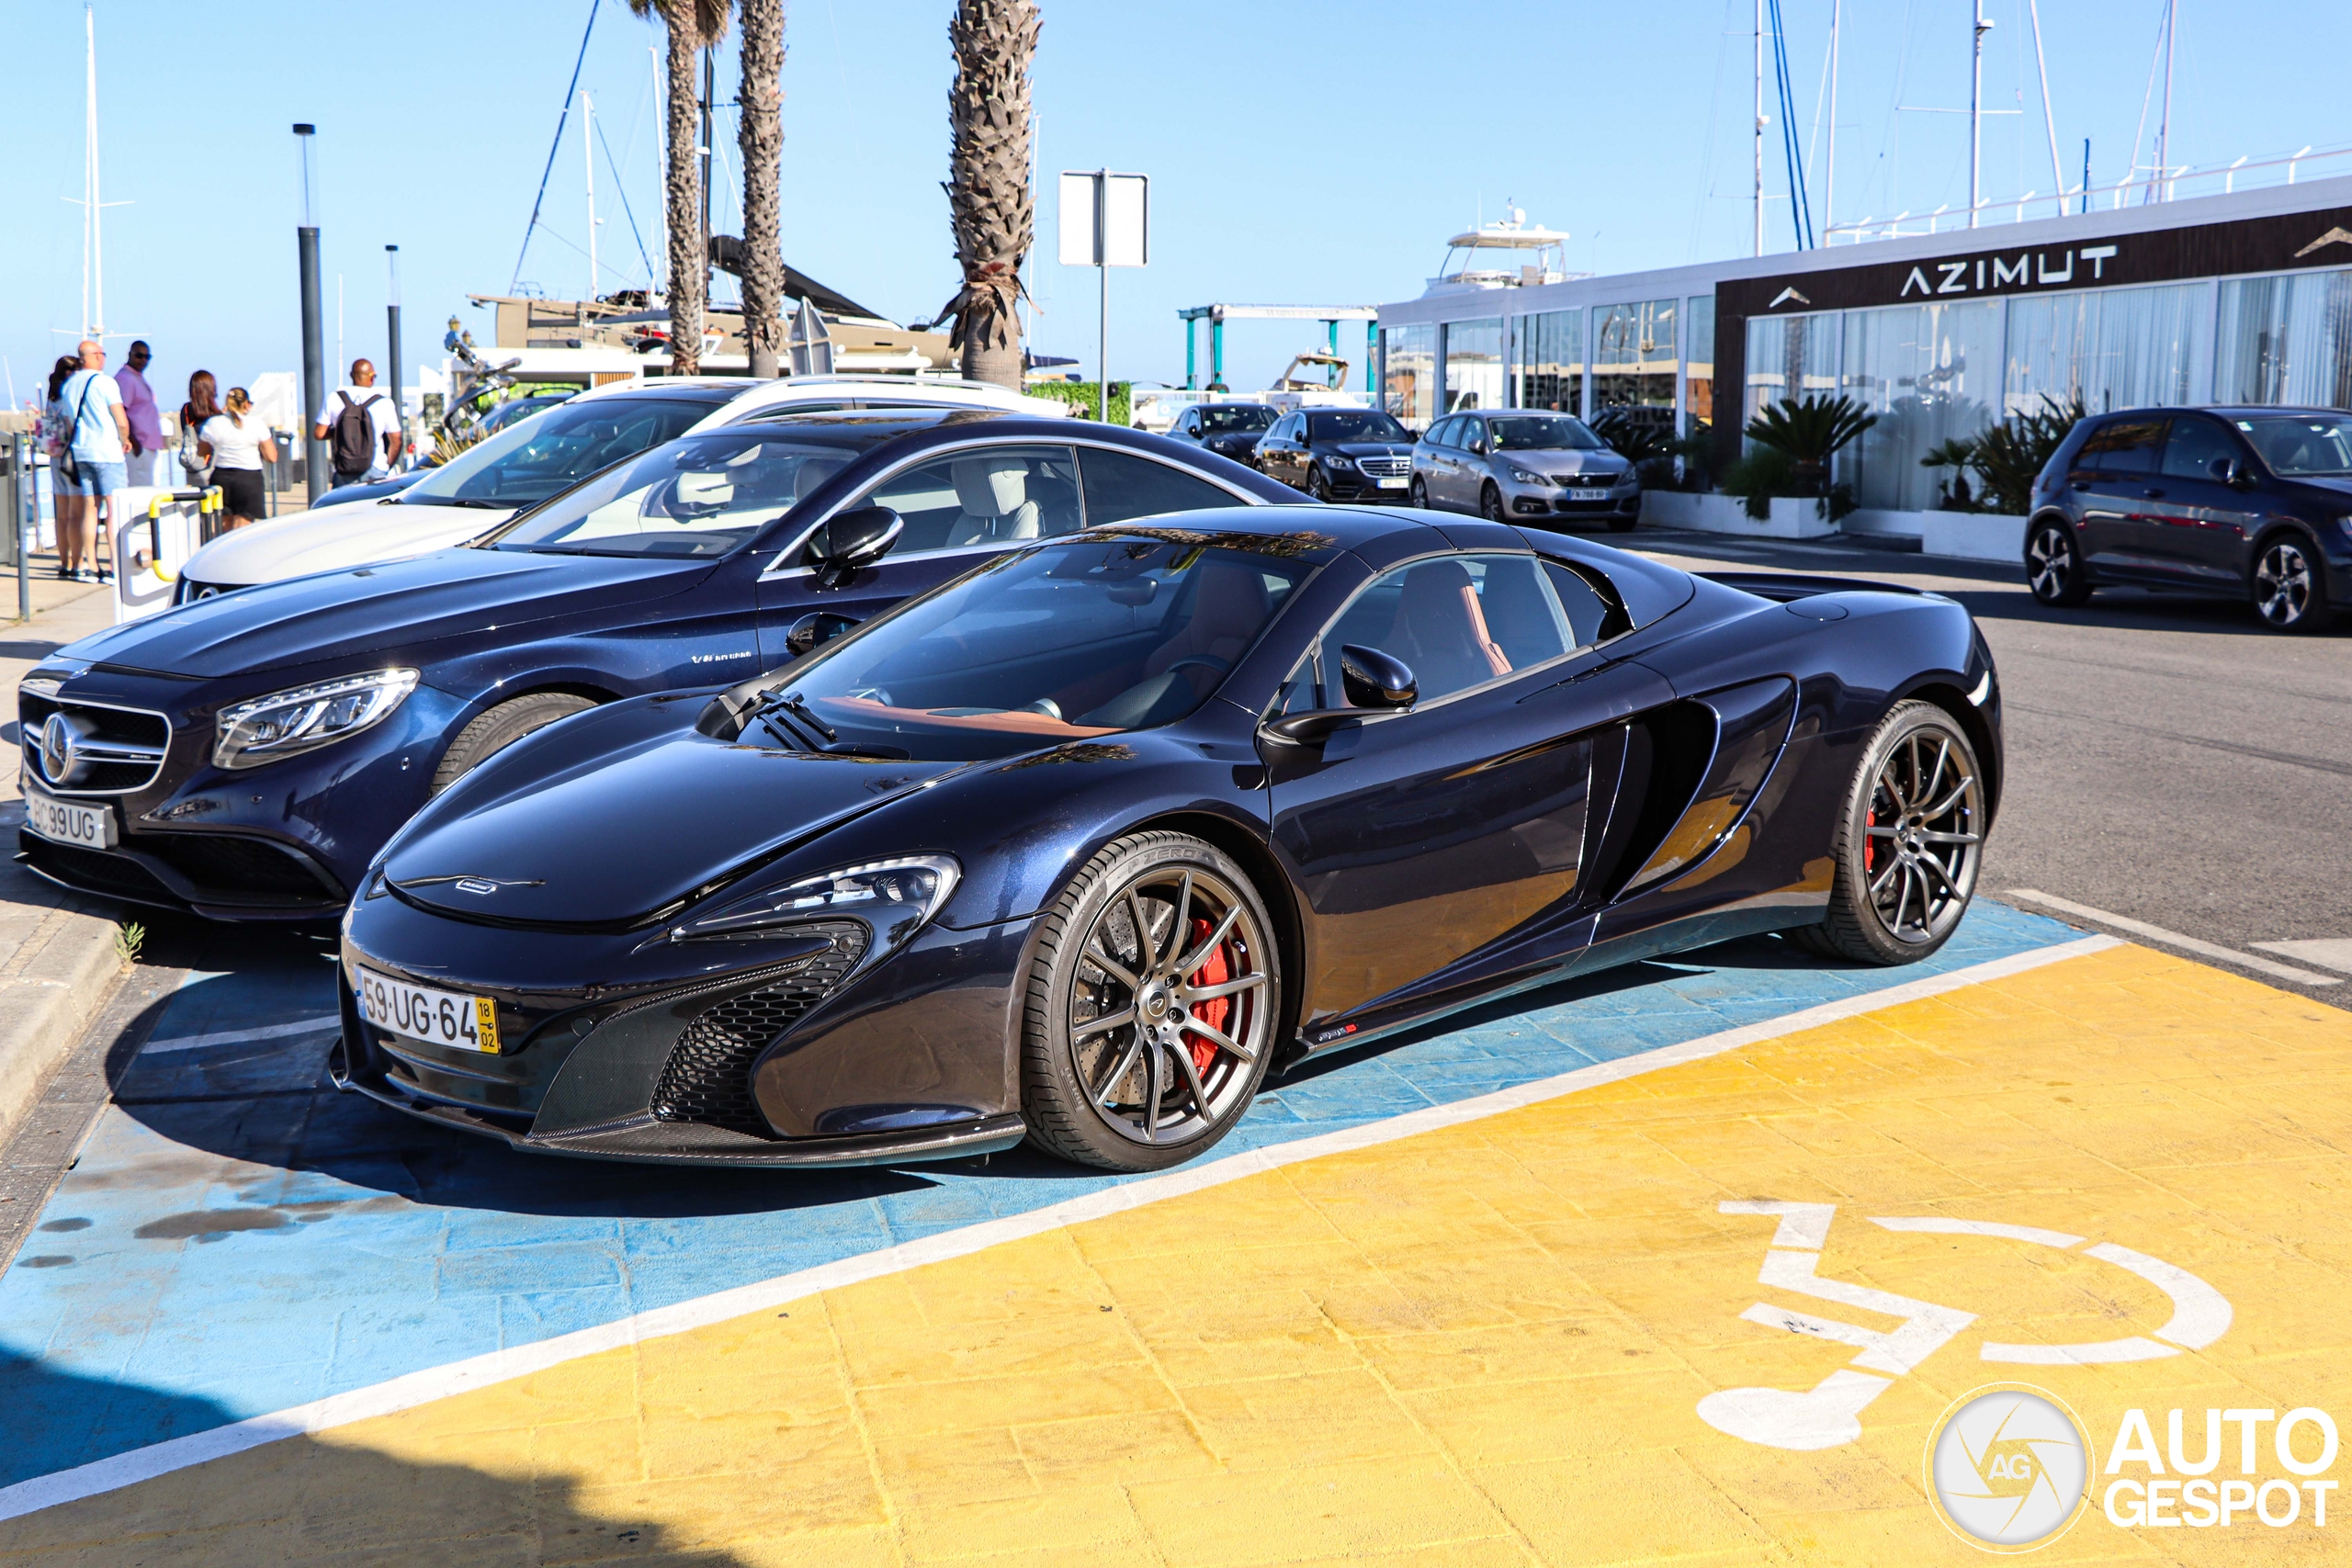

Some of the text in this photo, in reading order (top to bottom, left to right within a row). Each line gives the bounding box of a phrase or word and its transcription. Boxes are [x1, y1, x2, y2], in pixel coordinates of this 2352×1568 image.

[1900, 244, 2118, 298] AZIMUT
[1144, 848, 1196, 864] ZERO
[479, 1002, 491, 1018] 18
[481, 1032, 495, 1048] 02
